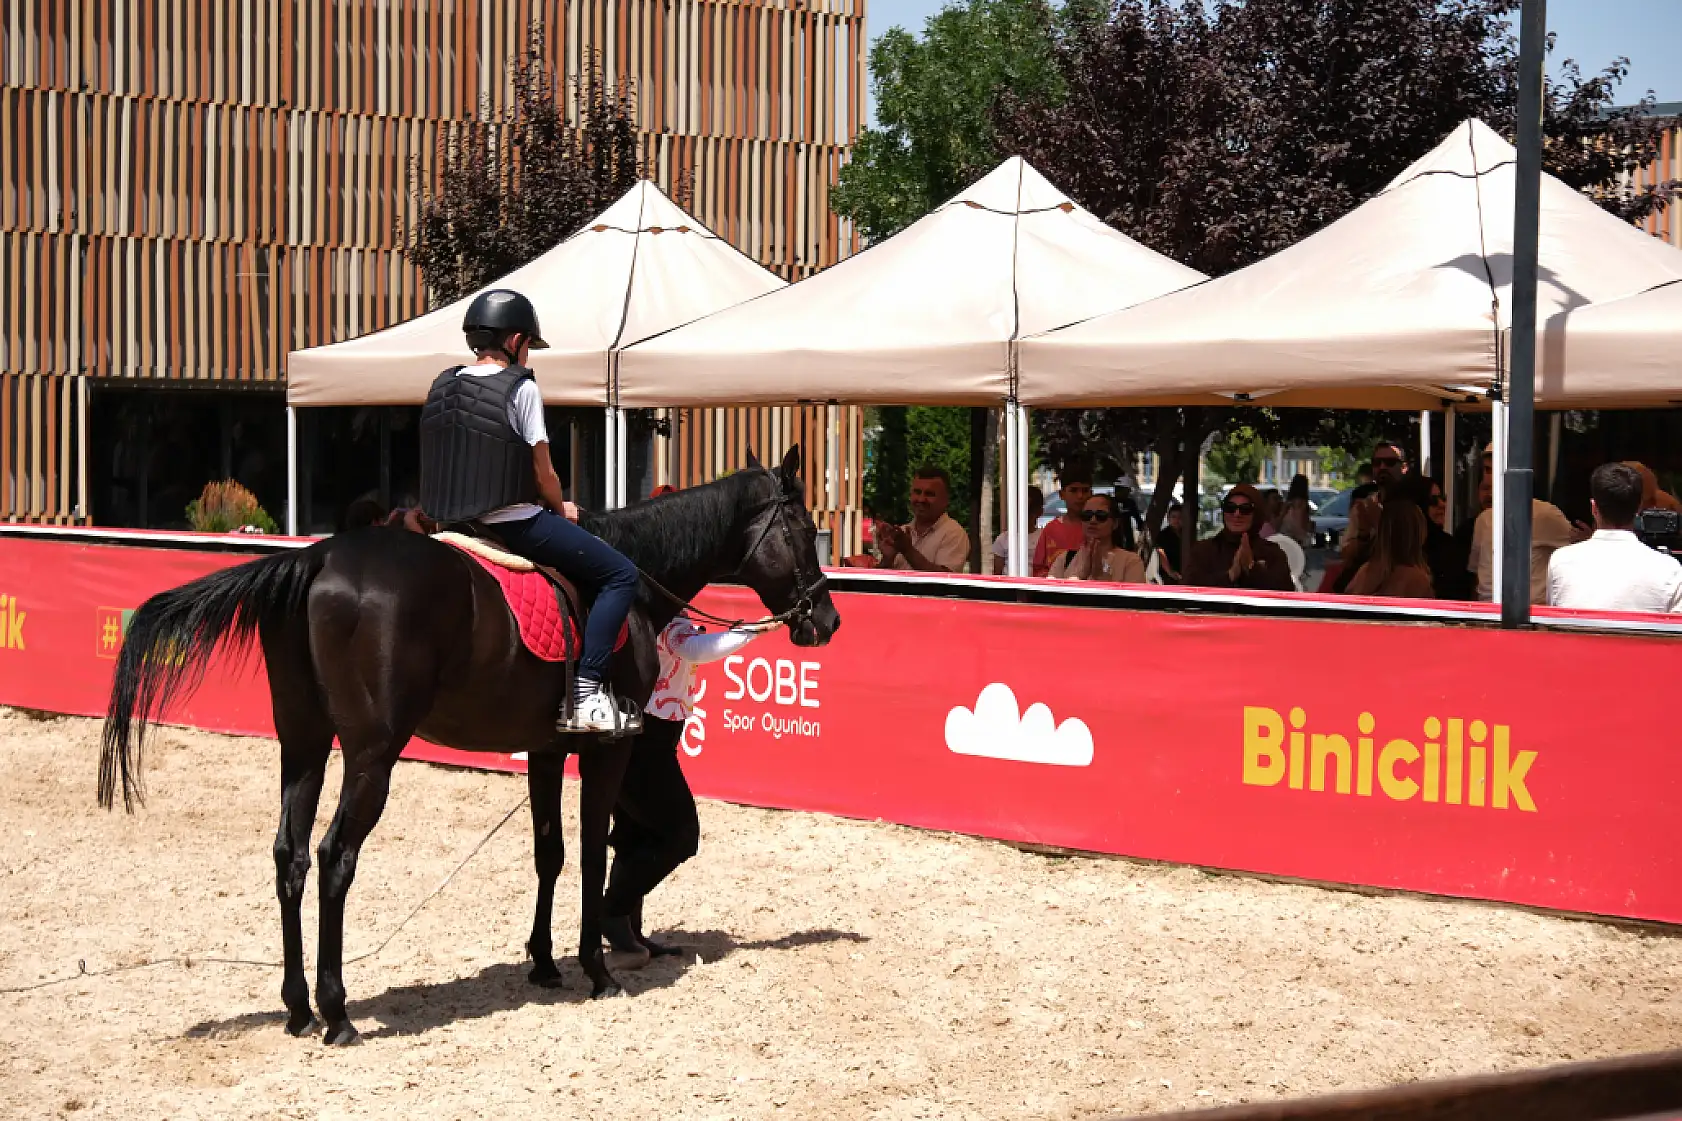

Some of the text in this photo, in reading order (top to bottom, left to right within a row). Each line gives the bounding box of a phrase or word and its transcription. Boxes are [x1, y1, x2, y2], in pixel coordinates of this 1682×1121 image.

[723, 655, 822, 708] SOBE
[723, 709, 756, 733] Spor
[1242, 706, 1539, 812] Binicilik
